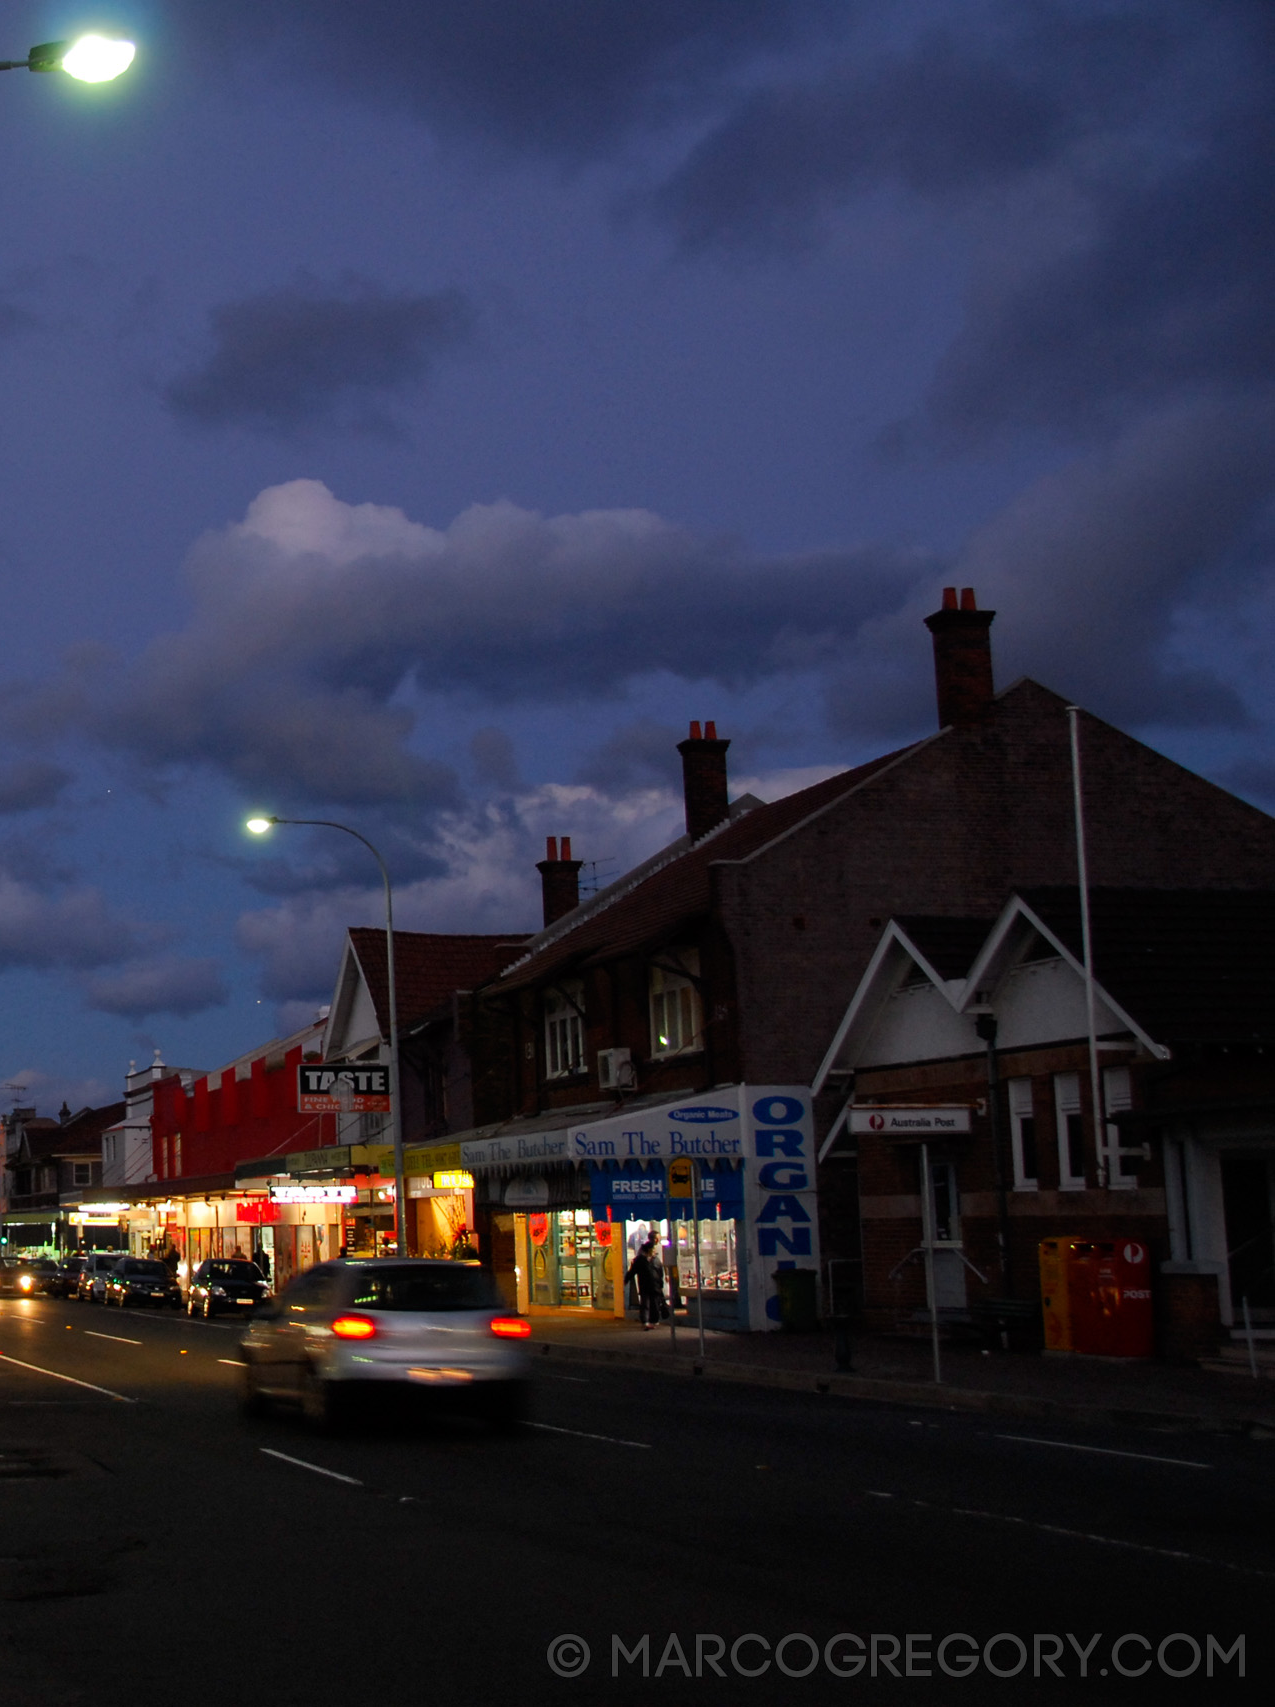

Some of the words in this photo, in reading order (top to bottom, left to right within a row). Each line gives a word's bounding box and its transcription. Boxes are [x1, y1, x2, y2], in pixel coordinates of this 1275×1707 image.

[305, 1071, 386, 1091] TASTE
[672, 1109, 706, 1120] Organic
[707, 1109, 734, 1119] Meats
[890, 1117, 931, 1127] Australia
[935, 1117, 955, 1127] Post
[461, 1144, 485, 1163] Sam
[489, 1140, 512, 1161] The
[518, 1136, 565, 1158] Butcher
[575, 1132, 616, 1155] Sam
[623, 1131, 661, 1155] The
[669, 1131, 740, 1154] Butcher
[611, 1180, 663, 1193] FRESH
[1123, 1289, 1153, 1299] POST
